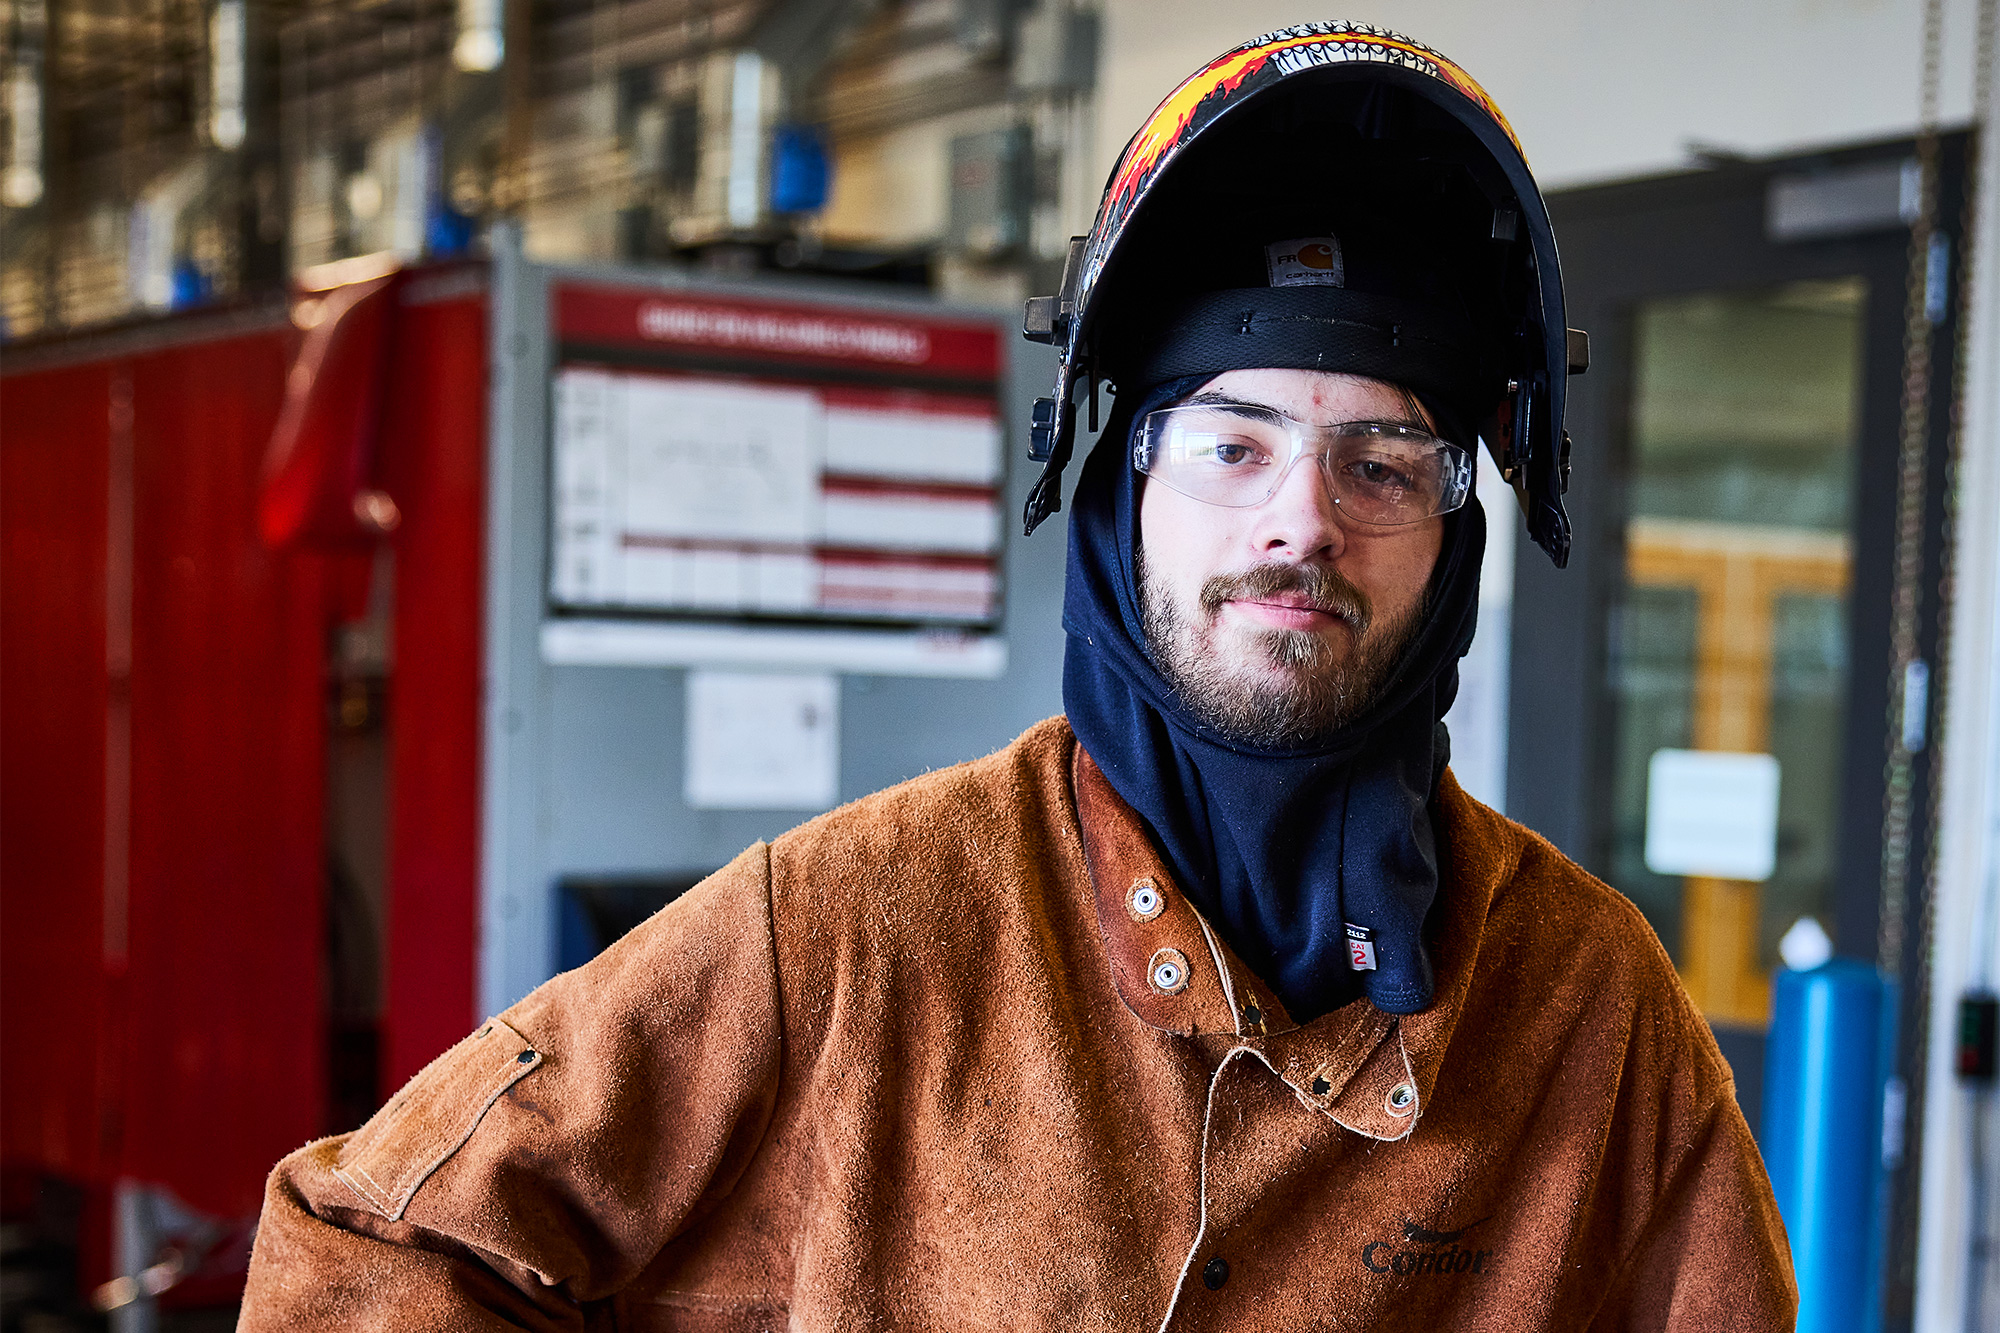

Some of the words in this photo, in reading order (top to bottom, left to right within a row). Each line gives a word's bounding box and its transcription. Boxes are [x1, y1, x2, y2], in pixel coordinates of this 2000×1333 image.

[1277, 254, 1297, 265] FR
[1285, 271, 1335, 279] carhartt
[1346, 929, 1367, 939] 2112
[1353, 950, 1367, 964] 2
[1361, 1241, 1493, 1275] Condor
